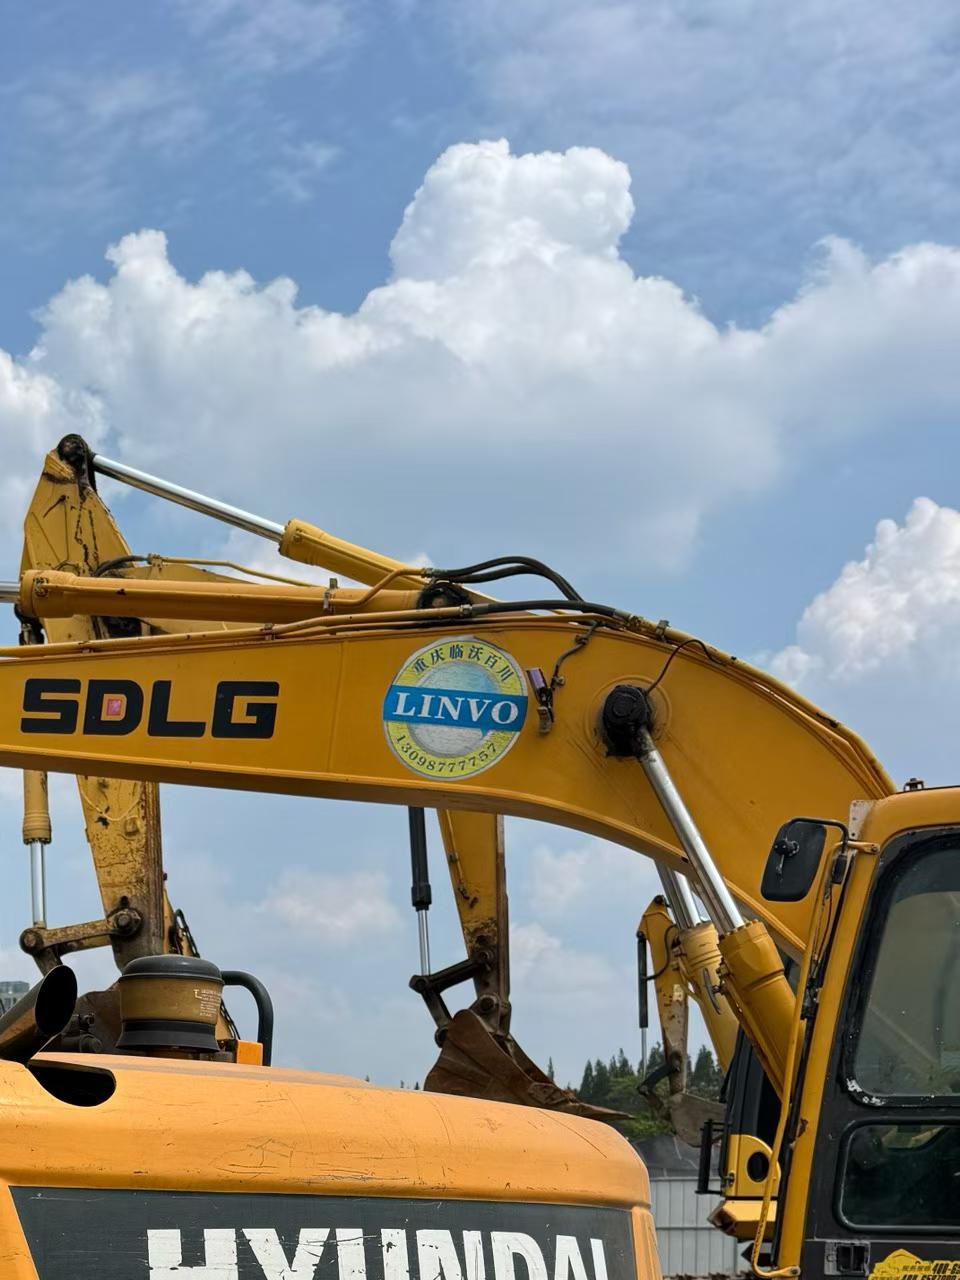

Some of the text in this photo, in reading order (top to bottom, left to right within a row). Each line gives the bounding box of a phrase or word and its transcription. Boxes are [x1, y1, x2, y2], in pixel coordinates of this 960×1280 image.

[413, 644, 515, 682] 重庆临沃百川
[20, 678, 280, 739] SDLG
[392, 691, 519, 725] LINVO
[396, 734, 497, 773] 13098777757
